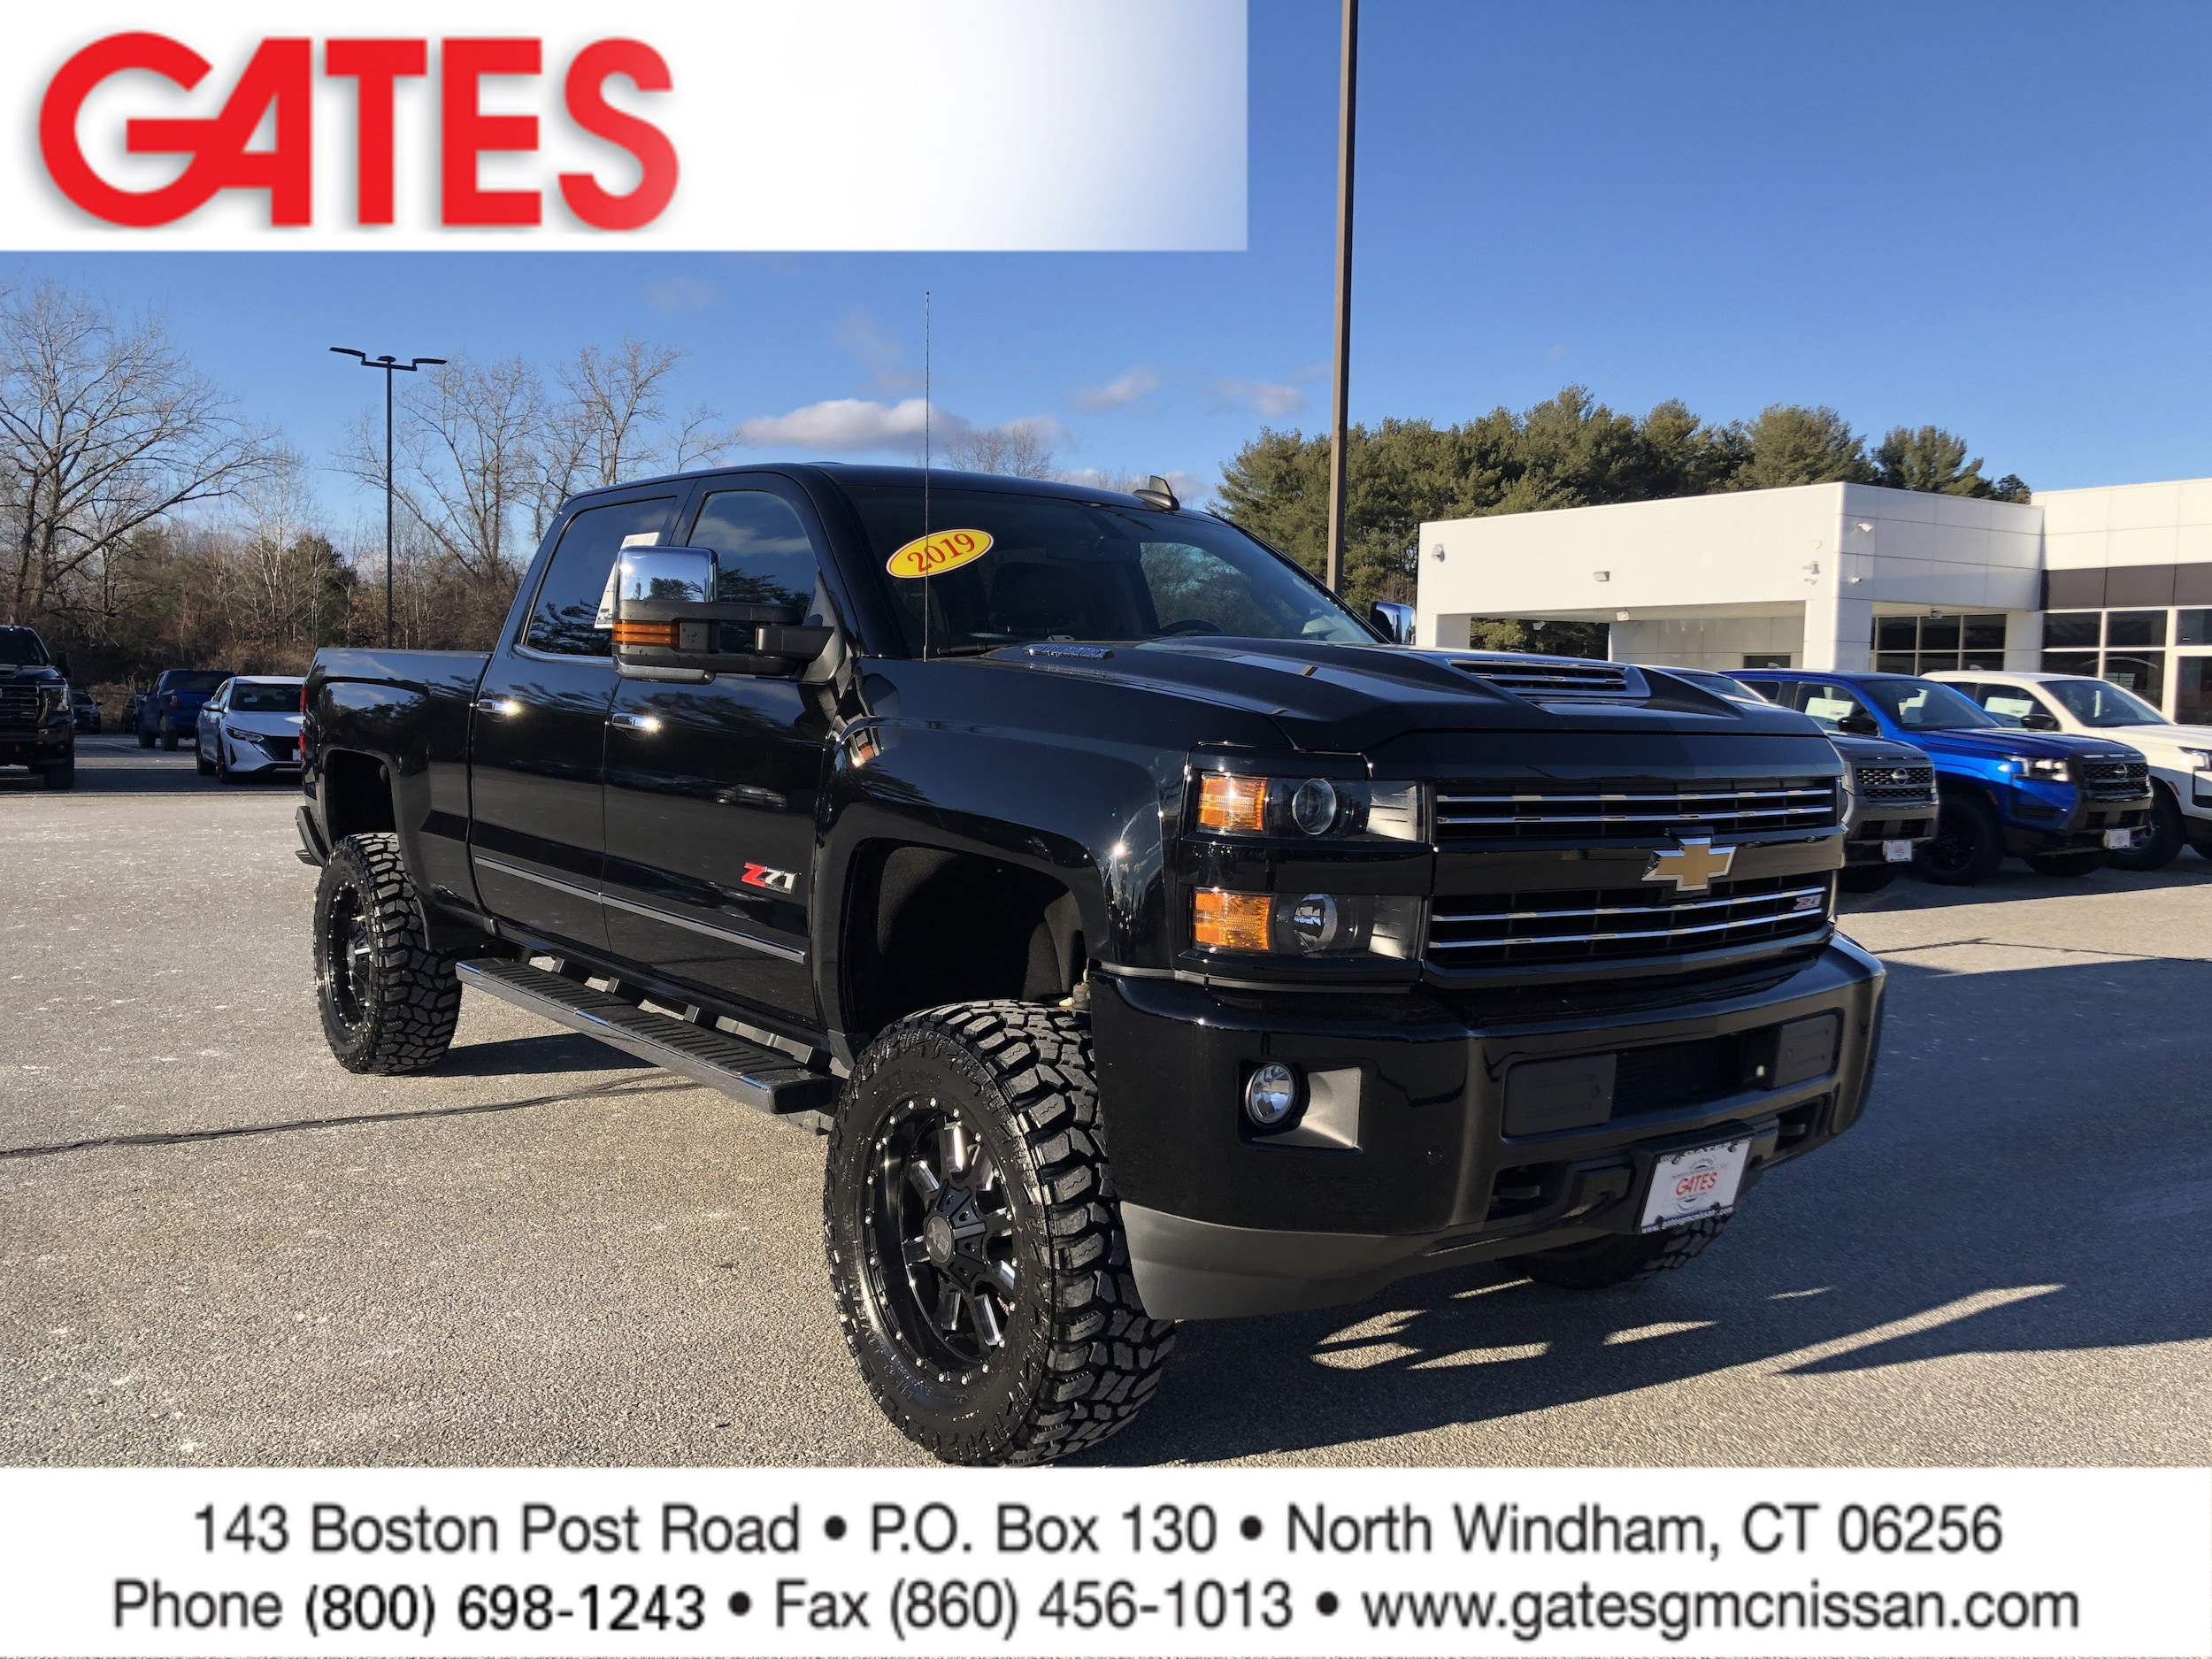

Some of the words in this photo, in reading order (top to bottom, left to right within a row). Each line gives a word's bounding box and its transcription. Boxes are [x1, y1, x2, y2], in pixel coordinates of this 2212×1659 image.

[907, 534, 975, 572] 2019
[741, 863, 795, 891] Z71
[1676, 1171, 1717, 1196] GATES
